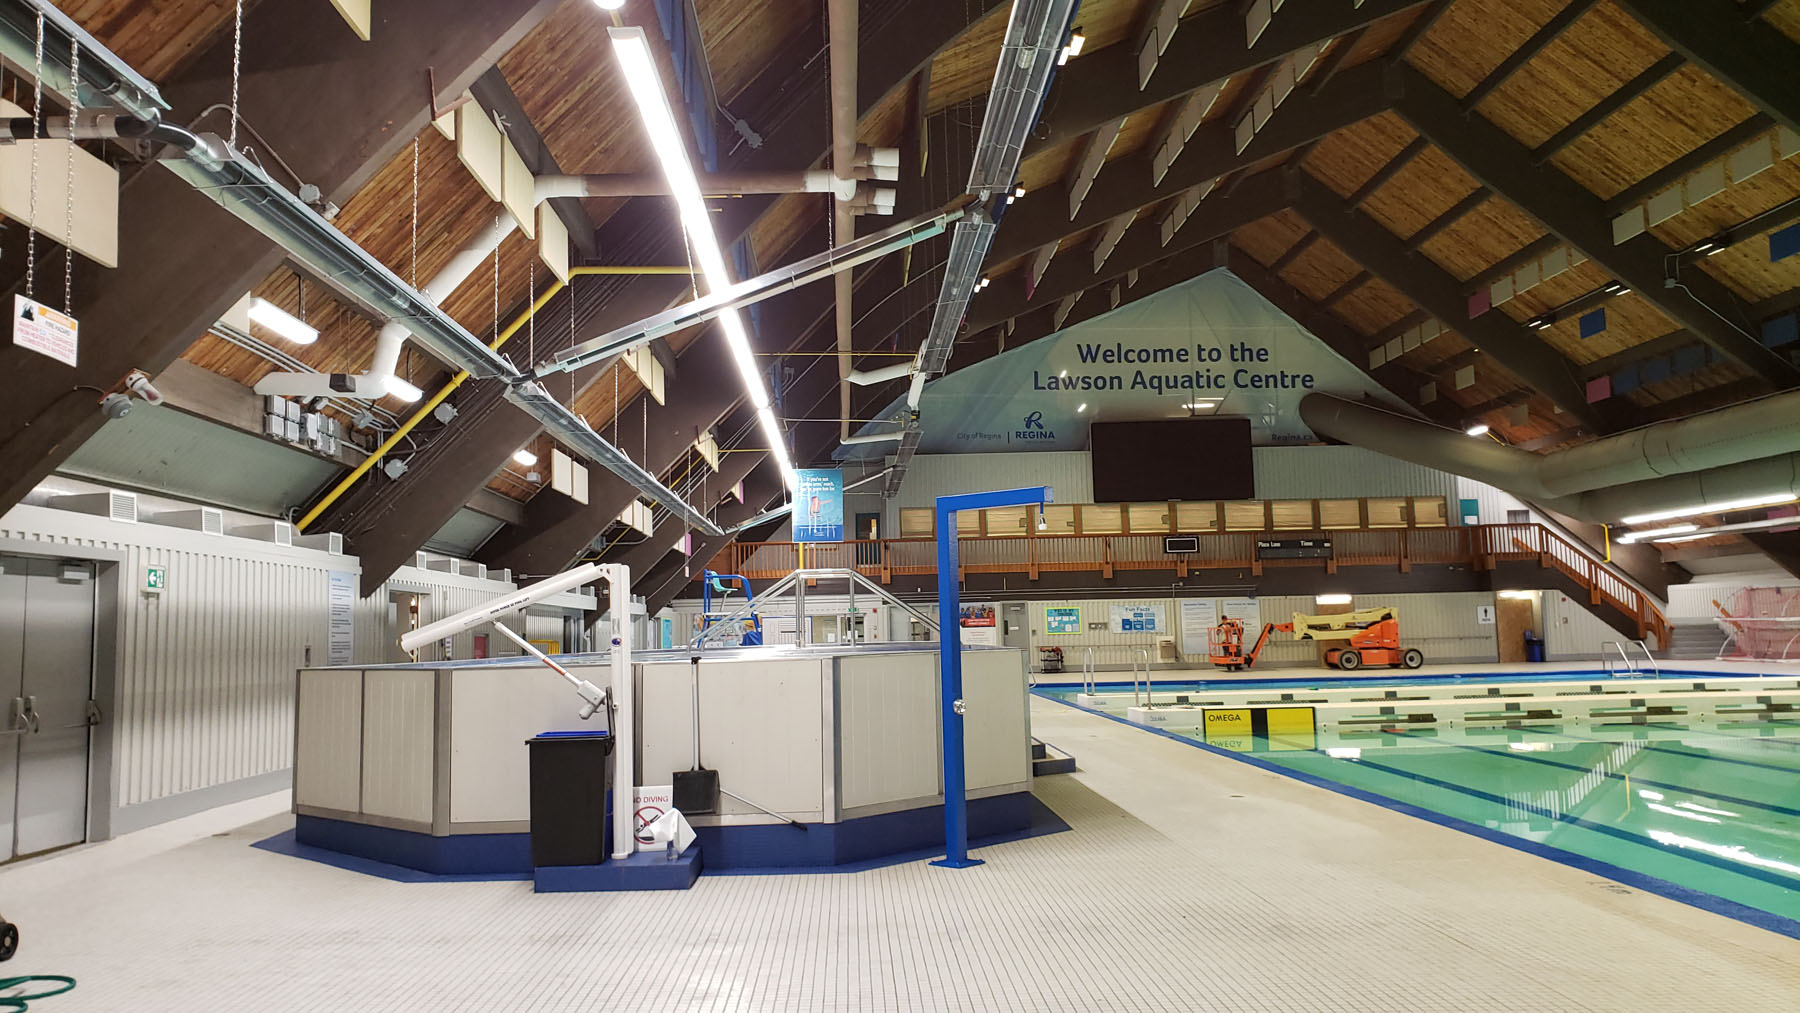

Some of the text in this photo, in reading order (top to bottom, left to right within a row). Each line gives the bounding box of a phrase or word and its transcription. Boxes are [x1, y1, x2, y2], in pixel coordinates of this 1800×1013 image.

[1076, 342, 1269, 363] Welcome to the
[1033, 368, 1314, 395] Lawson Aquatic Centre
[957, 431, 970, 441] City
[1015, 431, 1055, 440] REGINA
[1208, 714, 1242, 722] OMEGA
[643, 795, 669, 803] DIVING
